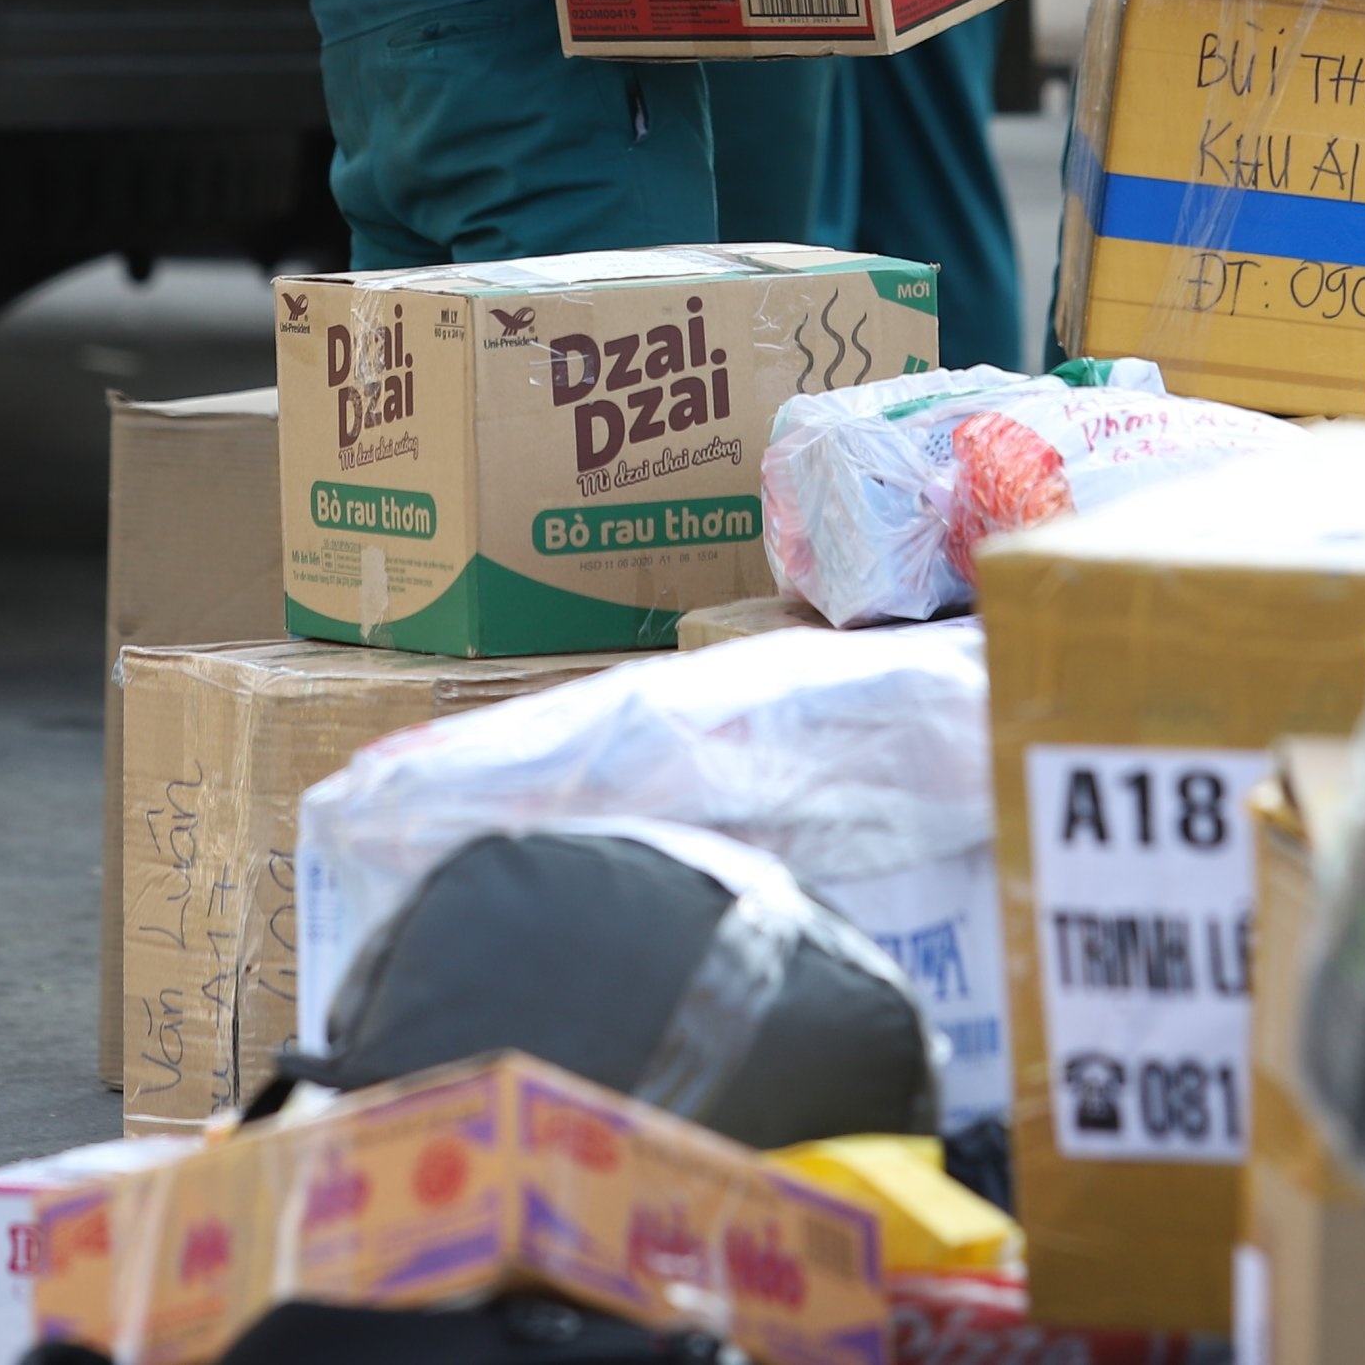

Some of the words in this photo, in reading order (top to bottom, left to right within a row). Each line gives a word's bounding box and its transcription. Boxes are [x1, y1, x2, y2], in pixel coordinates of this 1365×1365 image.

[1199, 119, 1292, 190] KHU
[897, 282, 931, 301] MỚI
[279, 322, 310, 335] Uni-President
[327, 303, 405, 388] Dai
[483, 335, 539, 350] Uni-President
[550, 296, 707, 407] Dzai
[338, 353, 414, 449] Dzai
[573, 348, 730, 473] Dzai
[357, 441, 374, 467] dzai
[577, 470, 611, 497] Mì
[614, 462, 651, 489] dzai
[653, 447, 689, 477] nhai
[692, 437, 743, 465] sướng
[317, 490, 342, 525] Bò
[346, 502, 376, 529] rau
[381, 500, 431, 535] thơm
[544, 513, 590, 549] Bò
[599, 519, 655, 547] rau
[665, 508, 754, 543] thơm
[580, 561, 602, 572] HSD
[1062, 767, 1230, 849] A18
[138, 760, 203, 949] Luân
[139, 988, 184, 1095] Văn
[1140, 1056, 1241, 1142] 081
